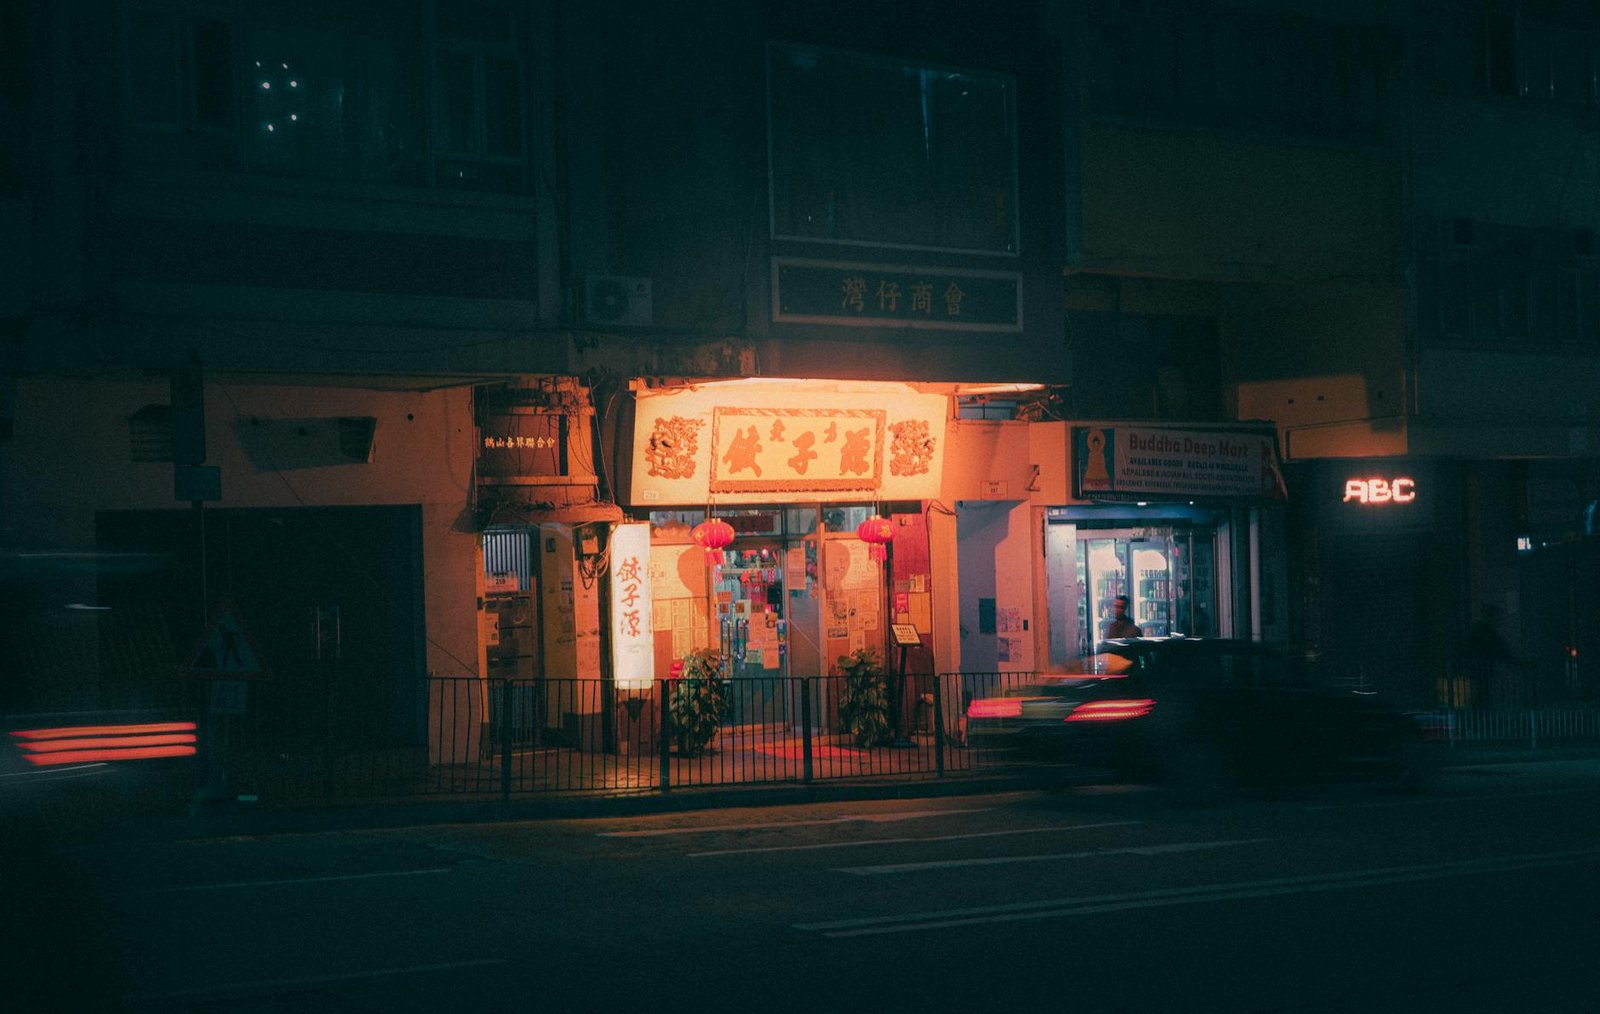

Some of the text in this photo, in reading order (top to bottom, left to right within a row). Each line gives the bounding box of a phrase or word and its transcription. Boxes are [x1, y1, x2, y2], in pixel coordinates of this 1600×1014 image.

[842, 277, 966, 316] 灣仔商會
[1130, 433, 1249, 458] Buddha Deep Mart
[1343, 479, 1415, 503] ABC
[616, 556, 642, 638] 餃子源
